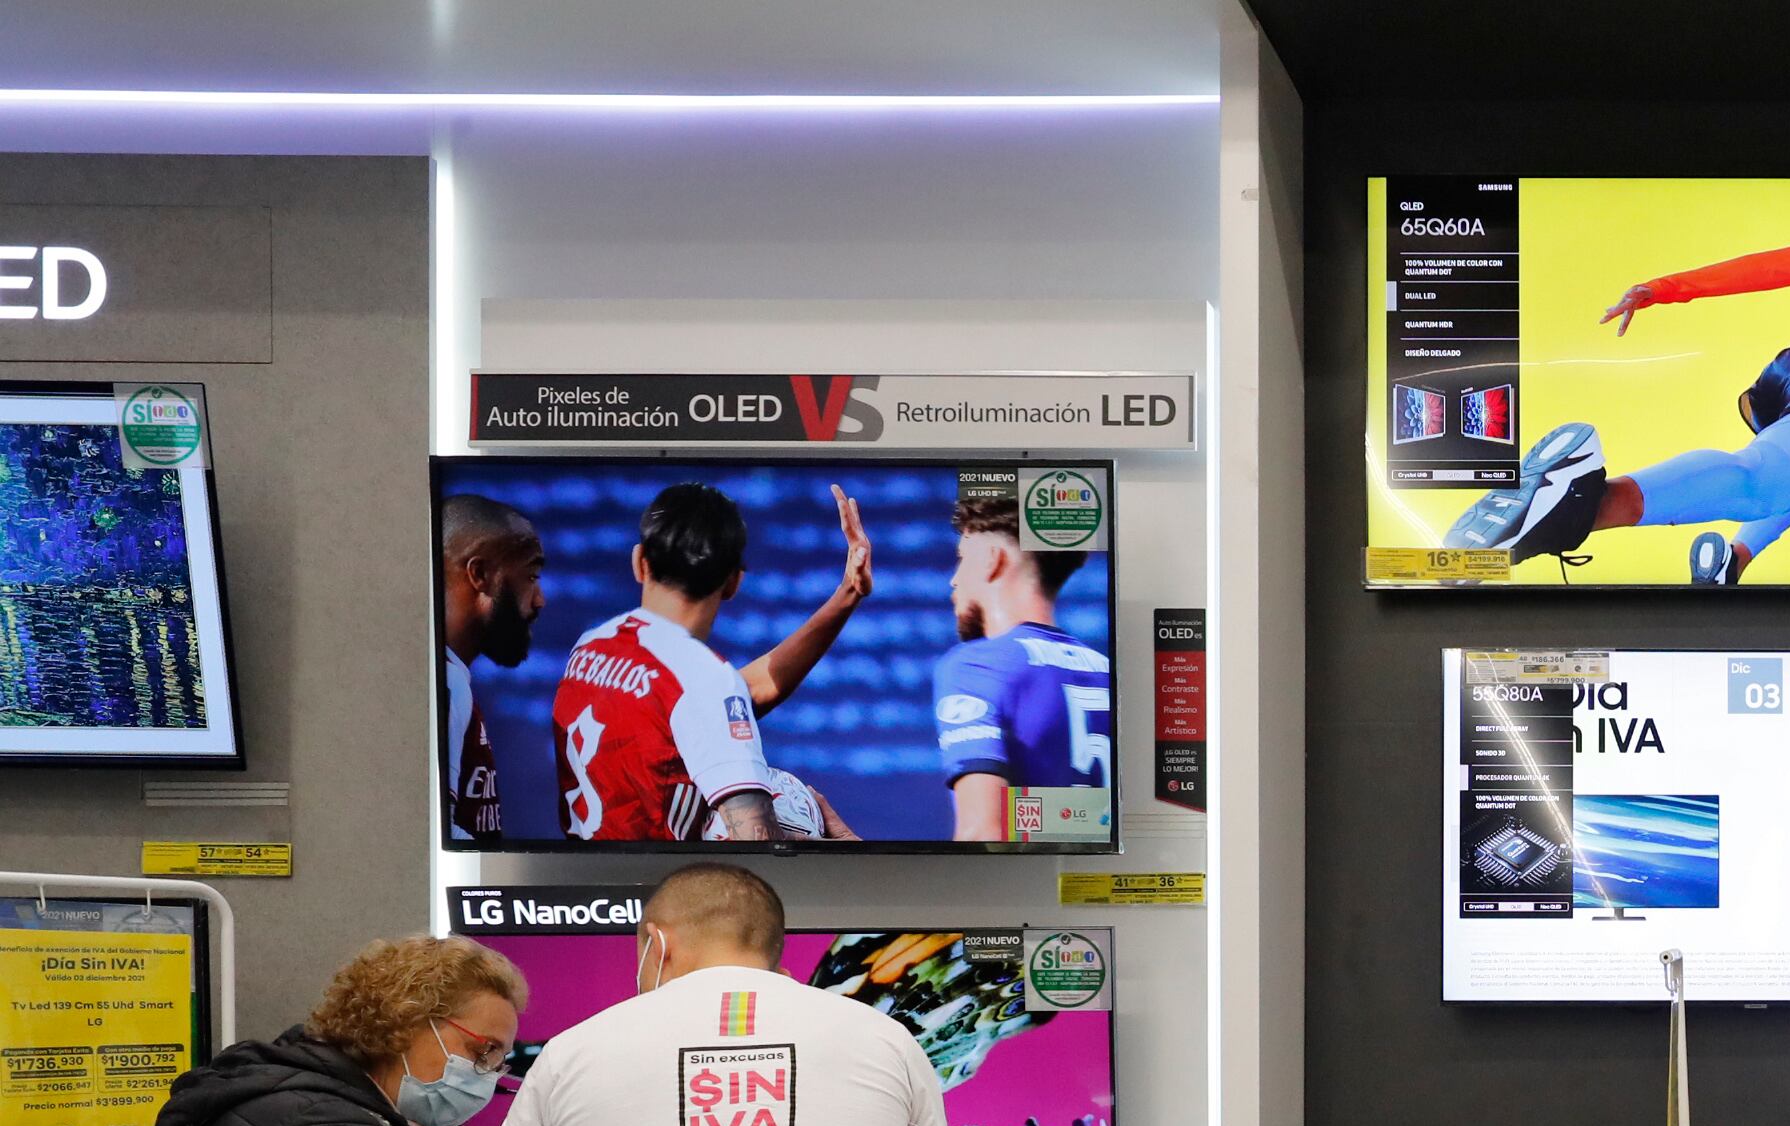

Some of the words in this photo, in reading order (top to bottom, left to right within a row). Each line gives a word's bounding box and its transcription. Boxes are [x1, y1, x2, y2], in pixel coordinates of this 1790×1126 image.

[1400, 202, 1424, 211] QLED
[1401, 218, 1485, 236] 65Q60A
[1425, 259, 1456, 267] VOLUMEN
[1405, 268, 1438, 276] QUANTUM
[1439, 268, 1452, 276] DOT
[1405, 321, 1438, 329] QUANTUM
[1405, 348, 1430, 357] DISEÑO
[538, 387, 601, 405] Pixeles
[606, 387, 630, 405] de
[688, 394, 783, 423] OLED
[896, 401, 1091, 424] Retroiluminación
[1101, 394, 1177, 427] LED
[487, 406, 542, 427] Auto
[548, 405, 680, 428] iluminación
[1036, 484, 1055, 507] SÍ
[1427, 552, 1449, 566] 16
[1159, 628, 1194, 639] OLED
[1162, 663, 1199, 673] Expresión
[1731, 662, 1751, 674] Dic
[1745, 683, 1781, 709] 03
[1598, 717, 1665, 754] IVA
[1181, 782, 1195, 791] LG
[1017, 818, 1040, 829] IVA
[200, 847, 215, 858] 57
[245, 847, 261, 858] 54
[1114, 877, 1129, 887] 41
[1159, 877, 1175, 887] 36
[462, 899, 505, 926] LG
[512, 898, 643, 925] NanoCell
[965, 936, 1020, 945] 2021NUEVO
[1041, 946, 1061, 969] SÍ
[41, 957, 75, 972] ¡Día
[81, 958, 107, 970] Sin
[111, 958, 145, 971] IVA!
[11, 1002, 26, 1010] Tv
[29, 1002, 50, 1010] Led
[53, 1002, 72, 1010] 139
[75, 1001, 94, 1010] Cm
[112, 1001, 134, 1010] Uhd
[139, 1001, 174, 1010] Smart
[87, 1018, 103, 1027] LG
[690, 1054, 716, 1064] Sin
[719, 1051, 785, 1063] excusas
[23, 1102, 56, 1111] Precio
[58, 1100, 93, 1110] normal
